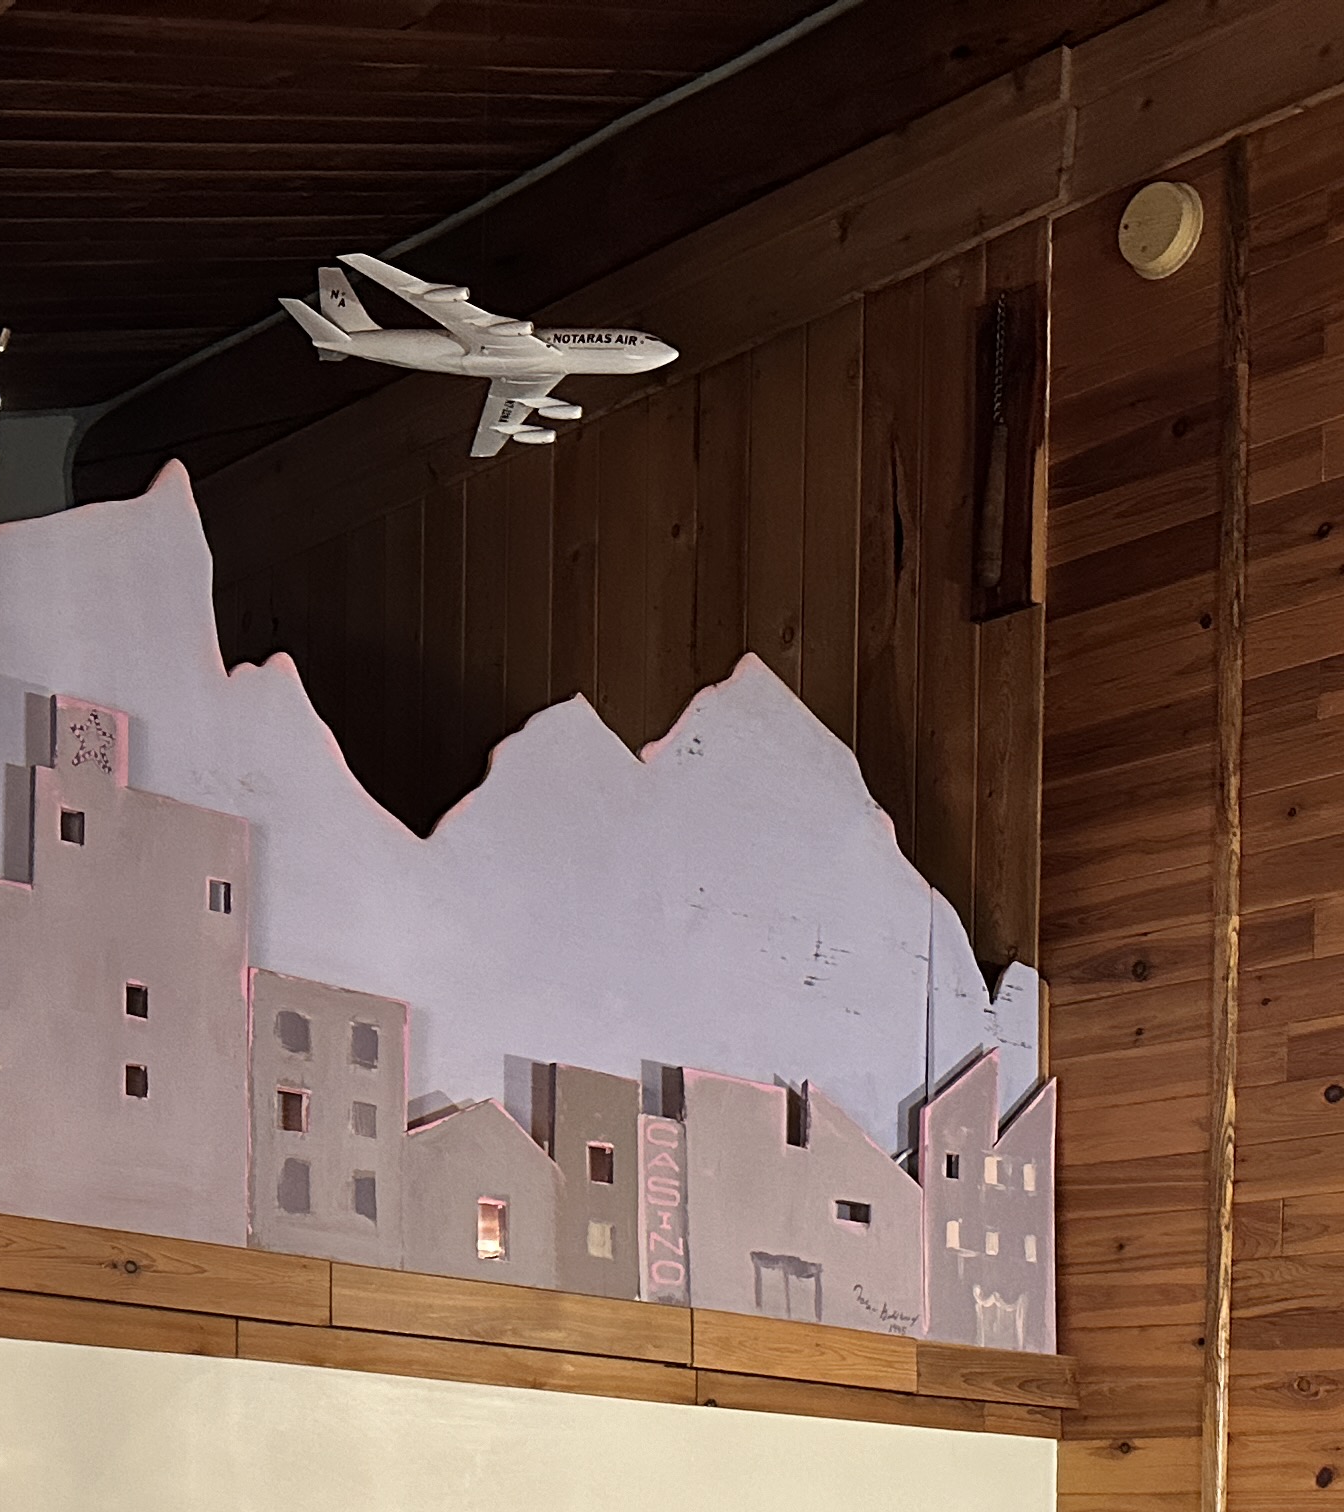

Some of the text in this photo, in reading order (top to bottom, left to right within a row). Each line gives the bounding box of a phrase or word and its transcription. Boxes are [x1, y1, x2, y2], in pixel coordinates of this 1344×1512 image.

[337, 297, 346, 308] A
[552, 333, 638, 347] NOTARAS AIR
[645, 1121, 686, 1287] CASINO
